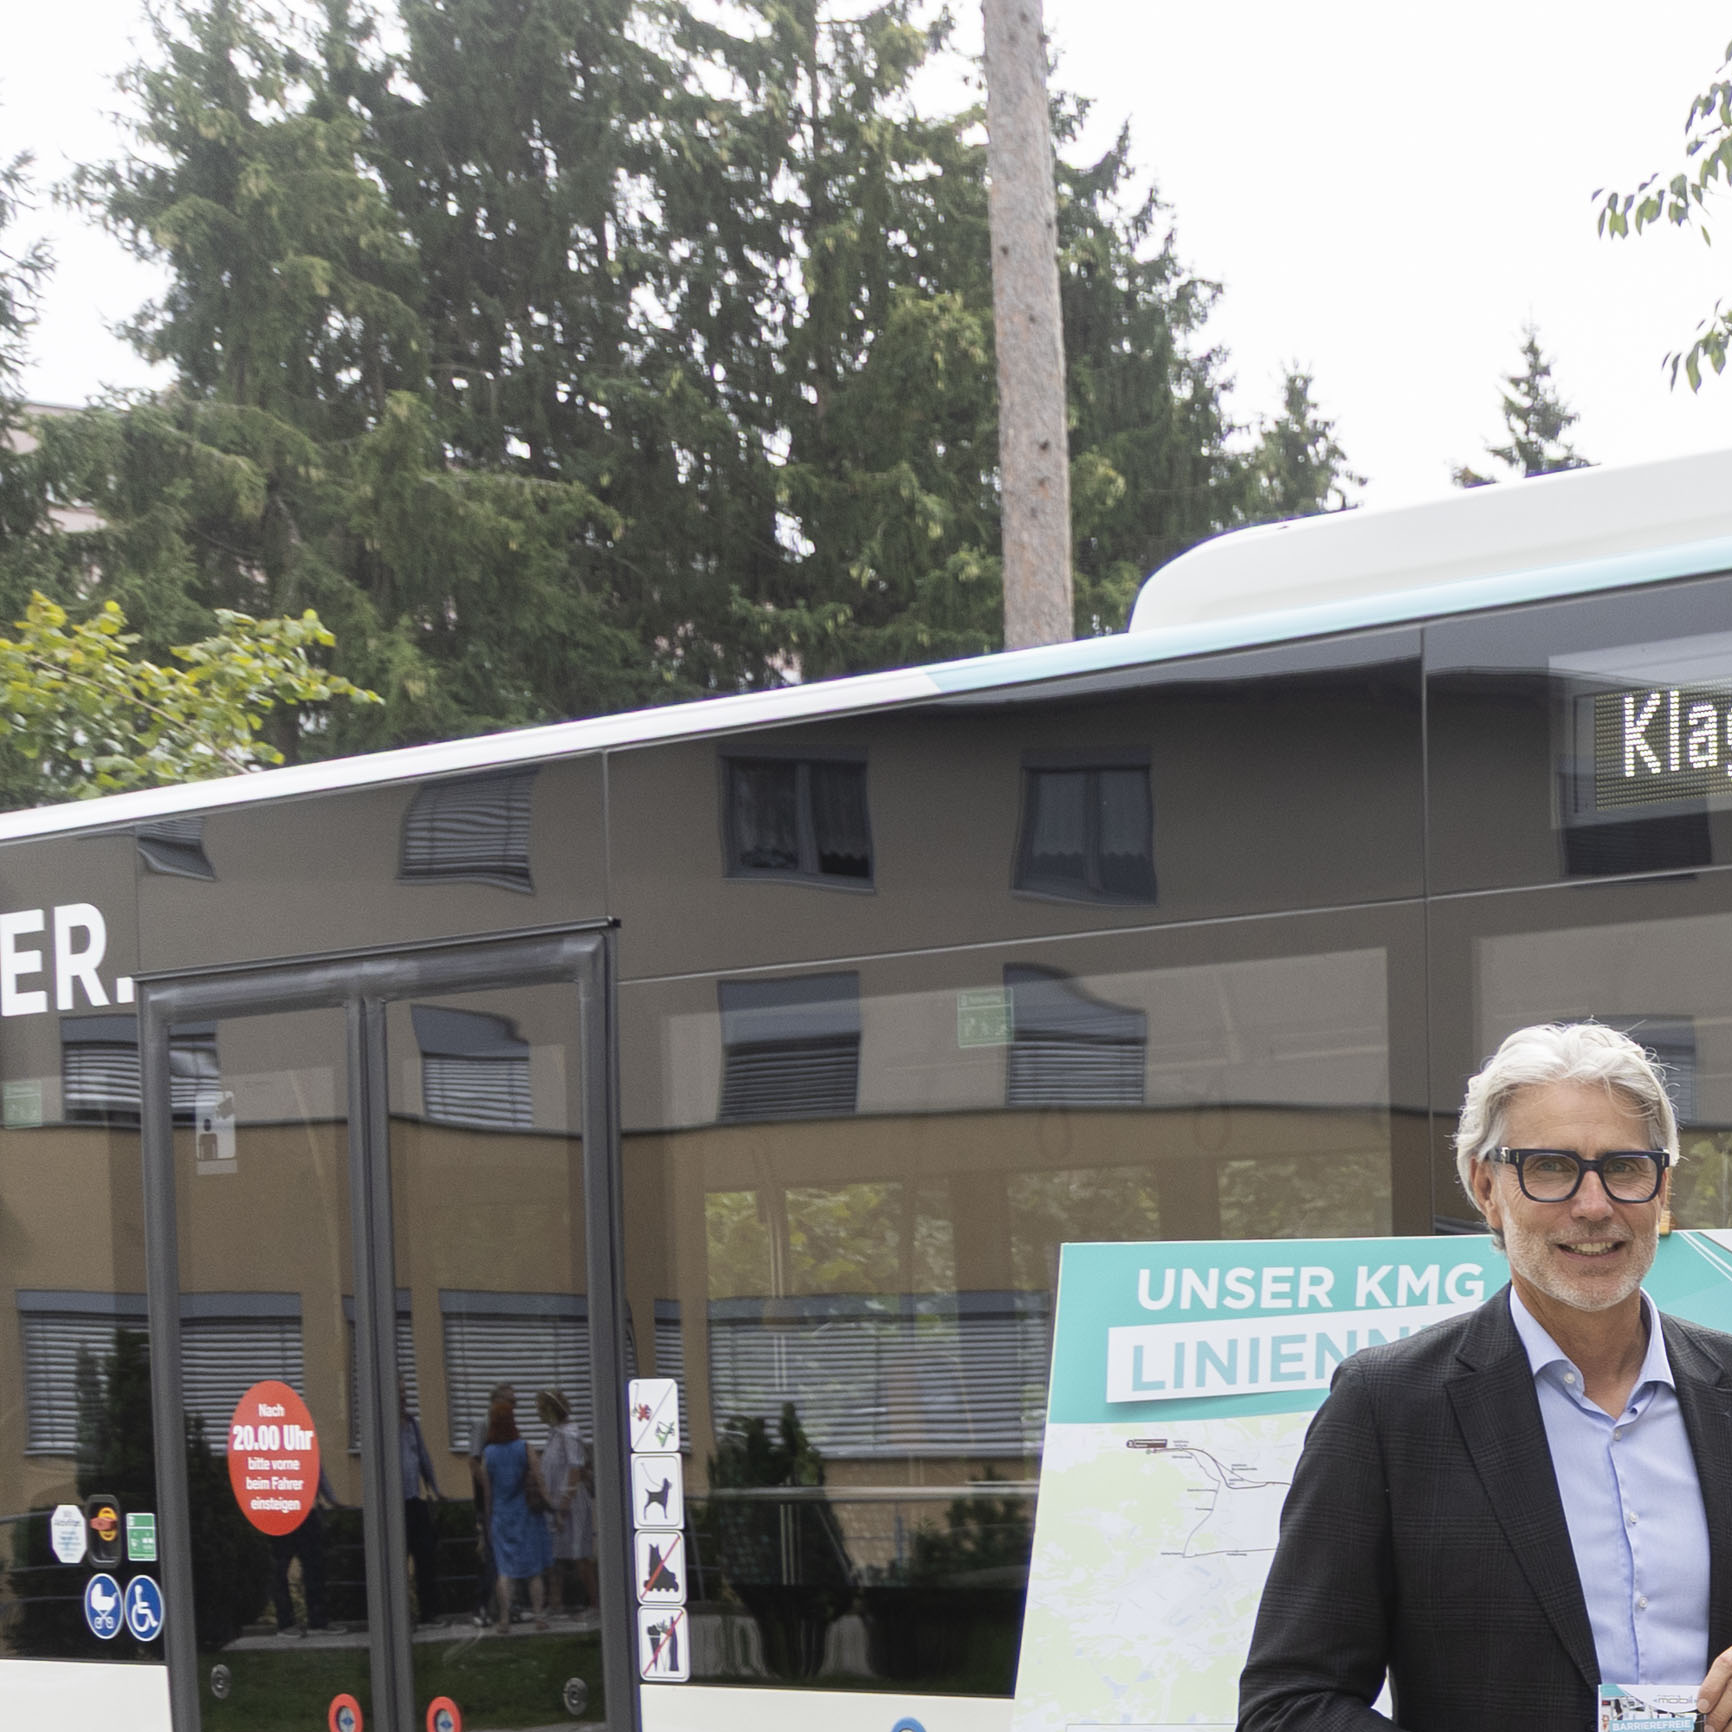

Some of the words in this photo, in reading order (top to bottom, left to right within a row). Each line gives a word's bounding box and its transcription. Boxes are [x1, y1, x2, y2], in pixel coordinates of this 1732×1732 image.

[0, 902, 135, 1017] ER.
[1137, 1266, 1334, 1310] UNSER
[1355, 1263, 1485, 1307] KMG
[258, 1403, 285, 1417] Nach
[233, 1425, 280, 1451] 20.00
[283, 1424, 314, 1451] Uhr
[248, 1457, 270, 1470] bitte
[272, 1460, 300, 1470] vorne
[246, 1477, 270, 1490] beim
[272, 1477, 303, 1490] Fahrer
[251, 1497, 301, 1513] einsteigen
[1612, 1719, 1692, 1731] BARRIEREFREIE
